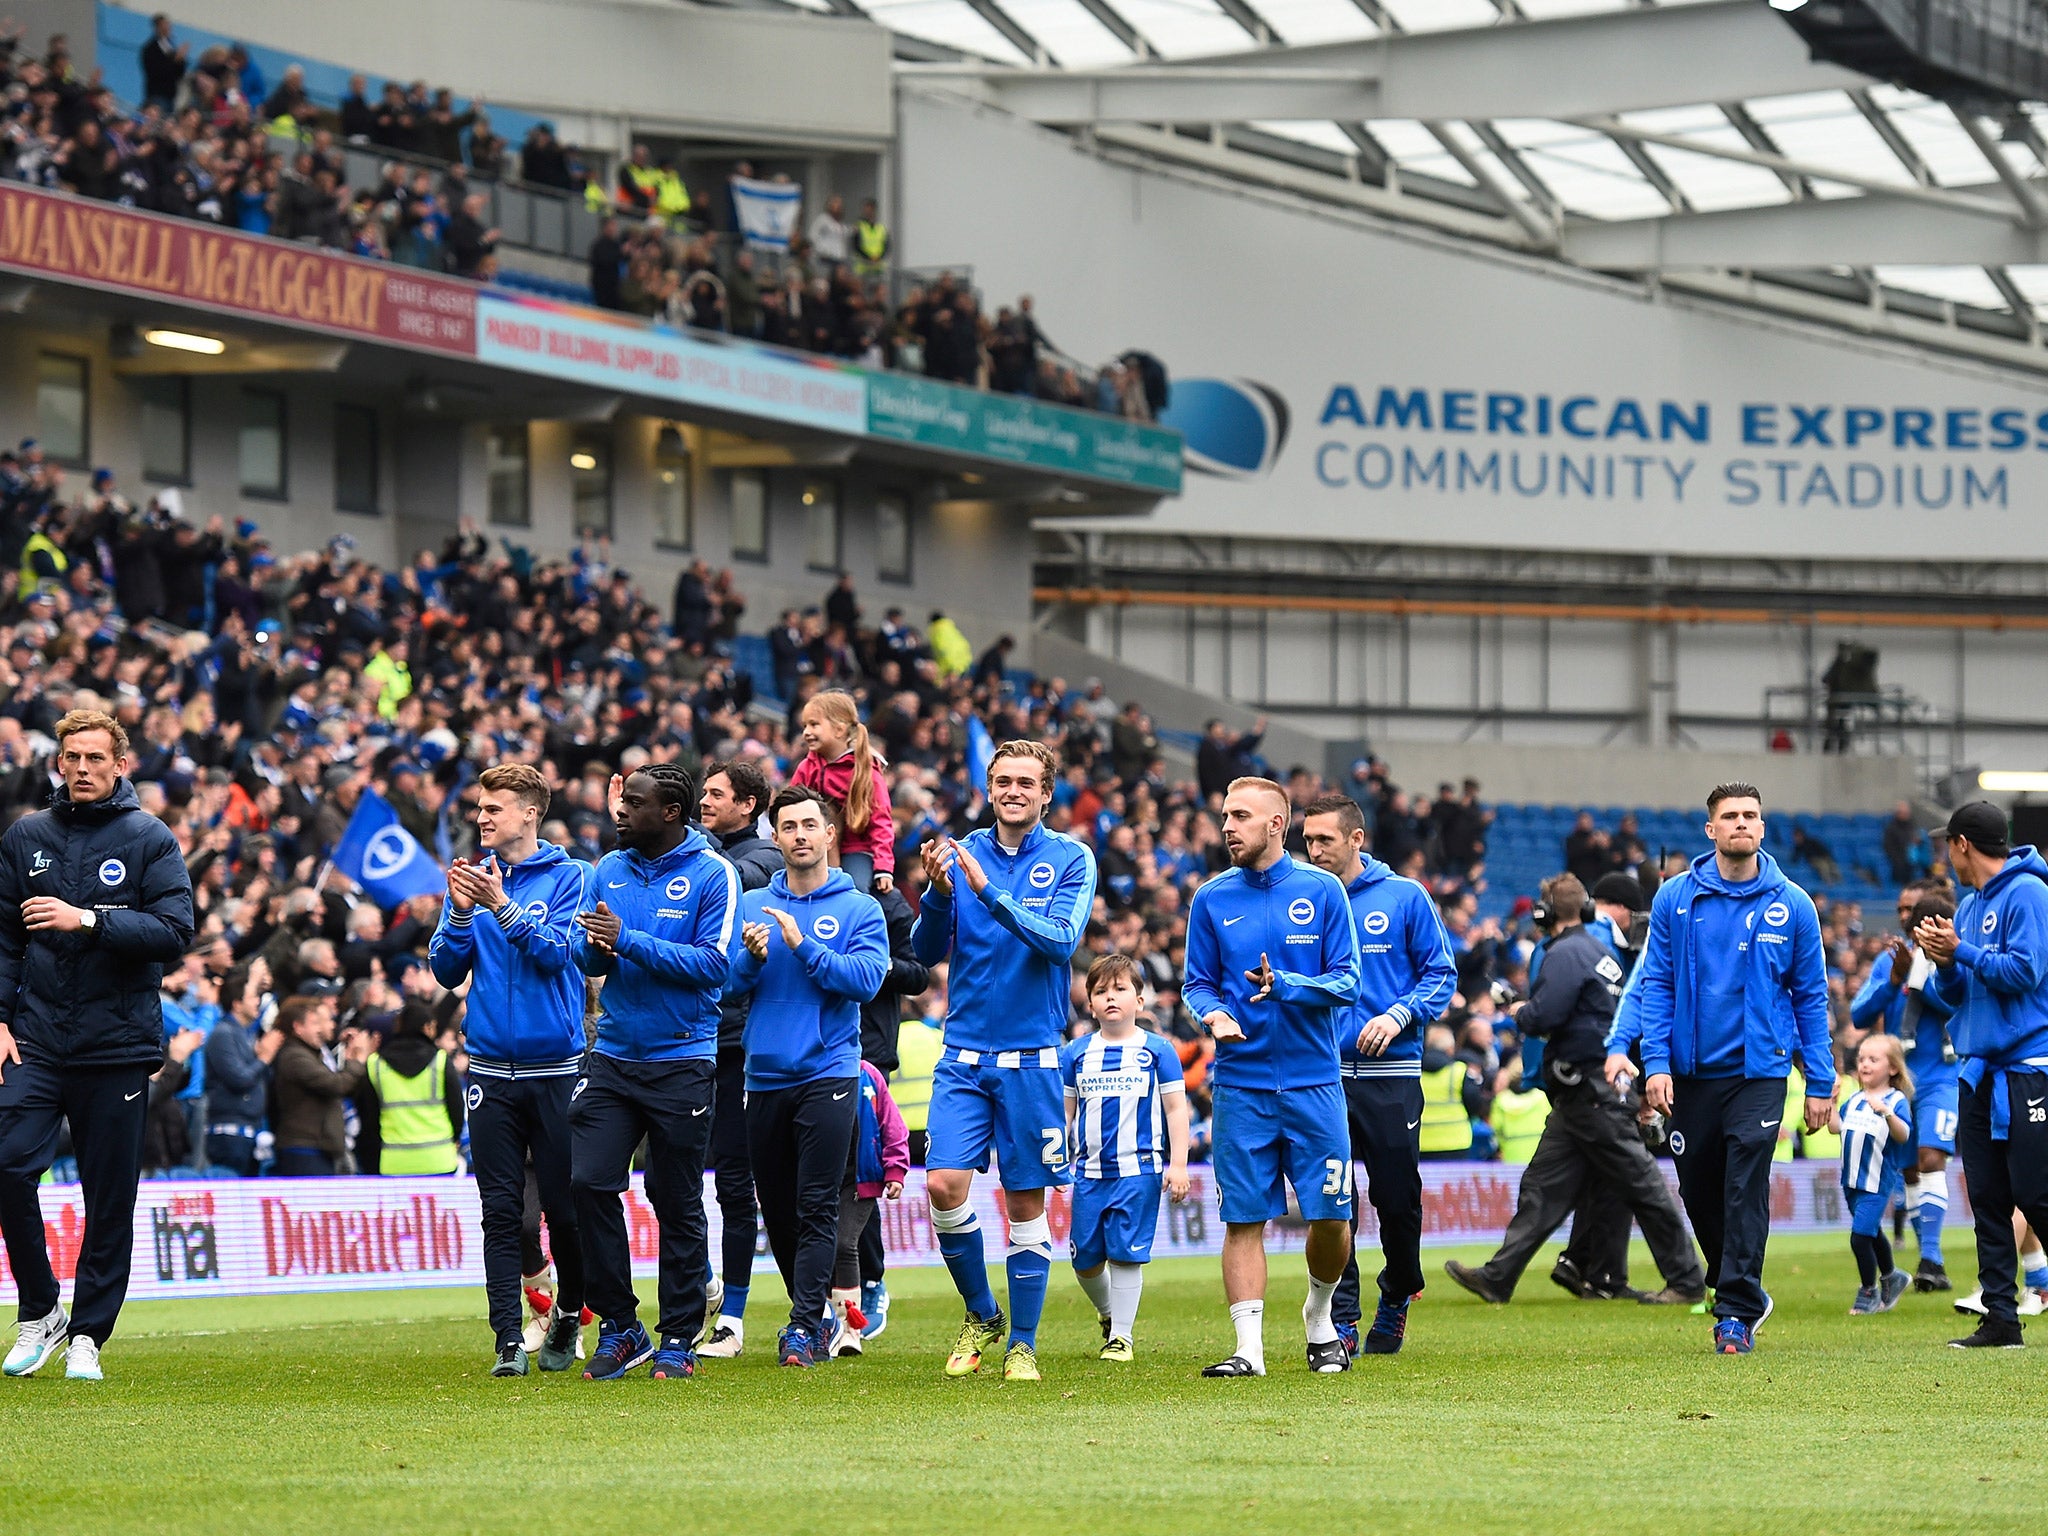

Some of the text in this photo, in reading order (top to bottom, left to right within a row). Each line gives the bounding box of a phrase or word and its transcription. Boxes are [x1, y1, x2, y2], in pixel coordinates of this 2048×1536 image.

[0, 193, 386, 330] MANSELL McTAGGART
[1319, 384, 1712, 444] AMERICAN
[1315, 440, 2009, 511] COMMUNITY STADIUM
[1081, 1076, 1143, 1085] AMERICAN
[1081, 1084, 1132, 1093] EXPRESS
[2028, 1107, 2047, 1123] 28
[261, 1194, 463, 1277] Donatello
